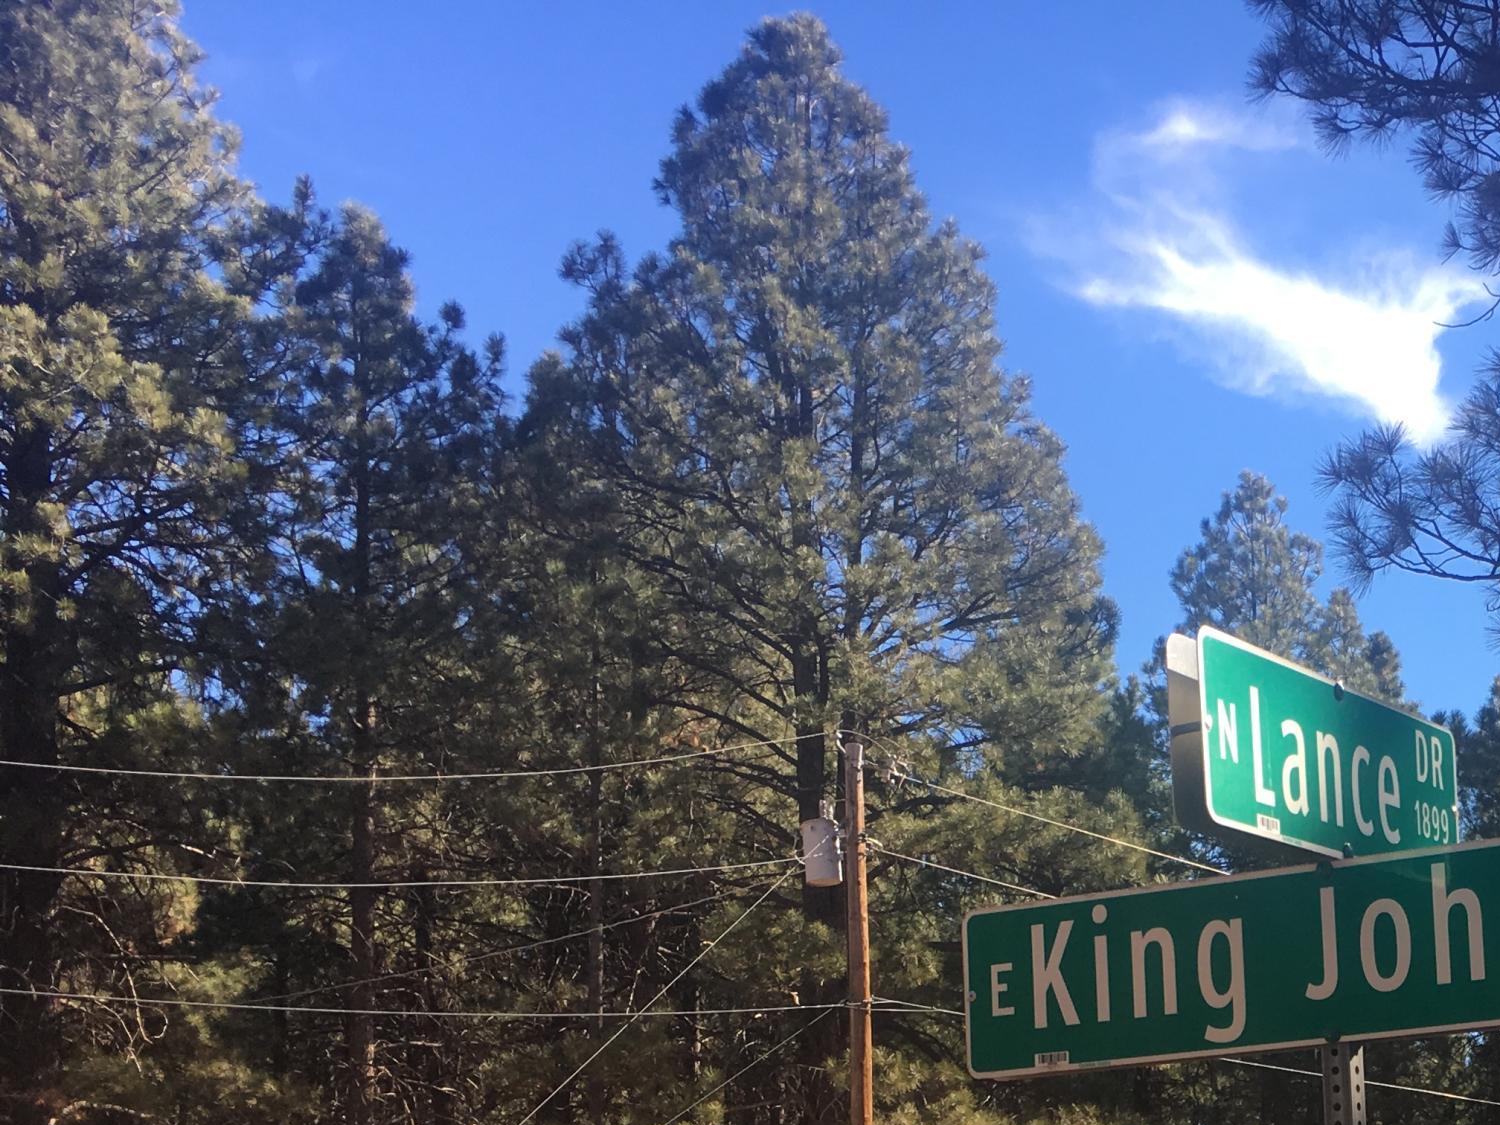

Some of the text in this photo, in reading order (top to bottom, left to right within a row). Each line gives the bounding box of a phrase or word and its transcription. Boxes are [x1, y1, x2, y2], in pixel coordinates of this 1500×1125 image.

[1217, 686, 1444, 844] N Lance DR
[1414, 800, 1449, 844] 1899
[990, 962, 1015, 1016] E
[1030, 904, 1247, 1043] King
